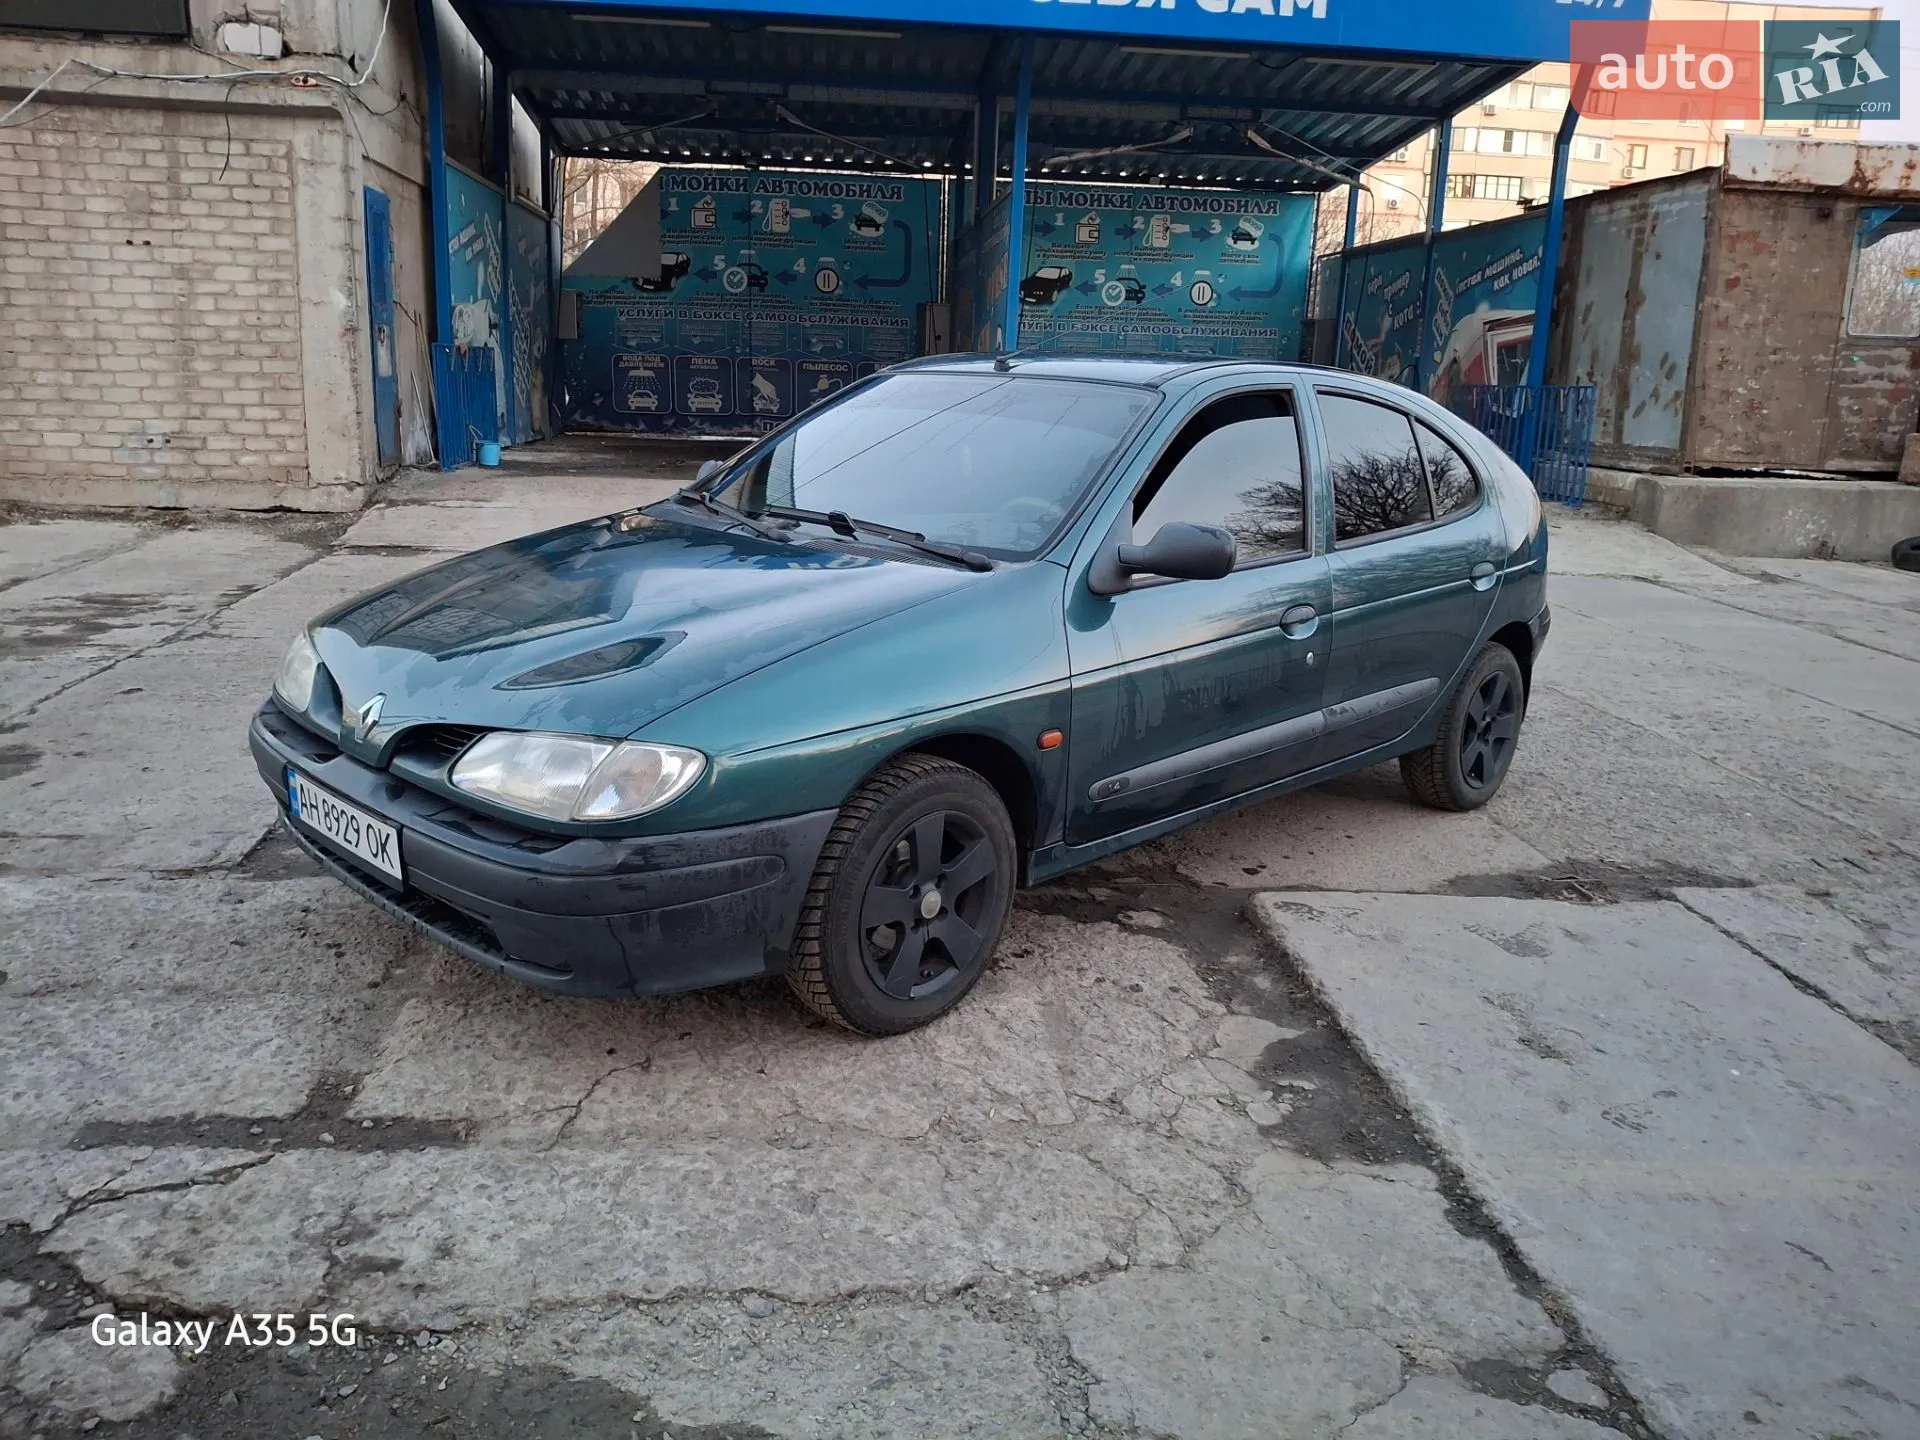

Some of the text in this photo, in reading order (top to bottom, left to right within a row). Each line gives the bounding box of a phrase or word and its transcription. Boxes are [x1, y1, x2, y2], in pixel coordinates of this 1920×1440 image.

[670, 173, 749, 193] МОЙКИ
[755, 179, 904, 201] АВТОМОБИЛЯ
[668, 197, 844, 219] 1 2 3
[1057, 190, 1133, 209] МОЙКИ
[1138, 195, 1279, 215] АВТОМОБИЛЯ
[1053, 213, 1222, 234] 1 2 3
[713, 255, 806, 273] 5 4
[1094, 269, 1182, 286] 5 4
[618, 308, 673, 319] УСЛУГИ
[679, 309, 688, 319] В
[693, 310, 741, 321] БОКСЕ
[746, 311, 909, 328] САМООБСЛУЖИВАНИЯ
[1058, 322, 1066, 332] В
[1070, 323, 1117, 333] БОКСЕ
[1121, 324, 1278, 338] САМООБСЛУЖИВАНИЯ
[691, 357, 717, 365] ПЕНА
[752, 359, 776, 367] ВОСК
[803, 363, 849, 371] ПЫЛЕСОС
[300, 783, 394, 868] AH 8929 OK
